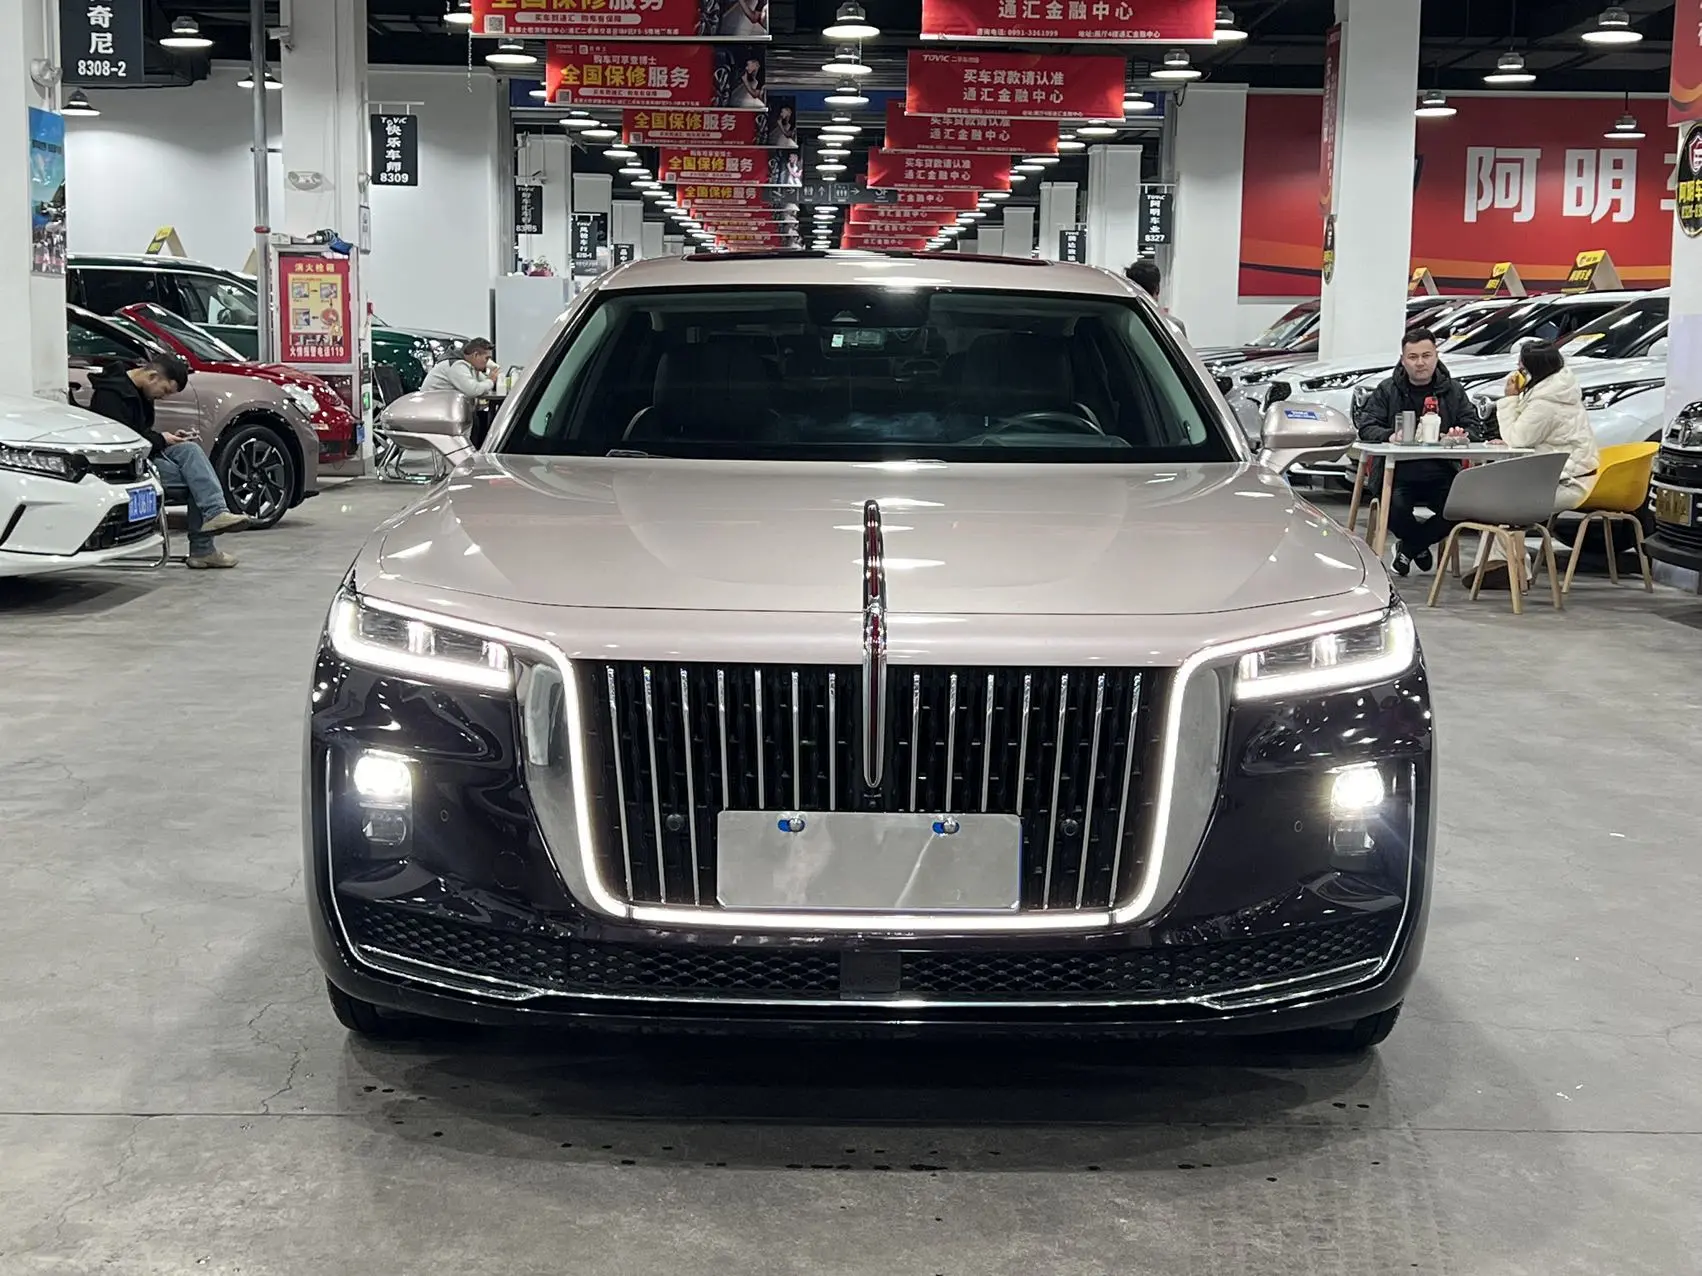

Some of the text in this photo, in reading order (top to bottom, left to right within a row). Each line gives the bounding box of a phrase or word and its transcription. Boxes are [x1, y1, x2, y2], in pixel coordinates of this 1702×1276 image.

[998, 0, 1133, 20] 通汇金融中心
[86, 0, 114, 54] 奇尼
[594, 55, 657, 65] 购车可享查博士
[922, 54, 950, 62] TOVIC
[78, 60, 126, 77] 8308-2
[560, 64, 690, 88] 全国保修服务
[964, 69, 1064, 86] 买车贷款请认准
[963, 87, 1064, 104] 通汇金融中心
[634, 112, 736, 131] 全国保修服务
[930, 128, 1011, 141] 通汇金融中心
[669, 156, 752, 172] 全国保修服务
[905, 158, 972, 169] 买车贷款请认准
[380, 172, 409, 183] 8309
[904, 170, 971, 181] 通汇金融中心
